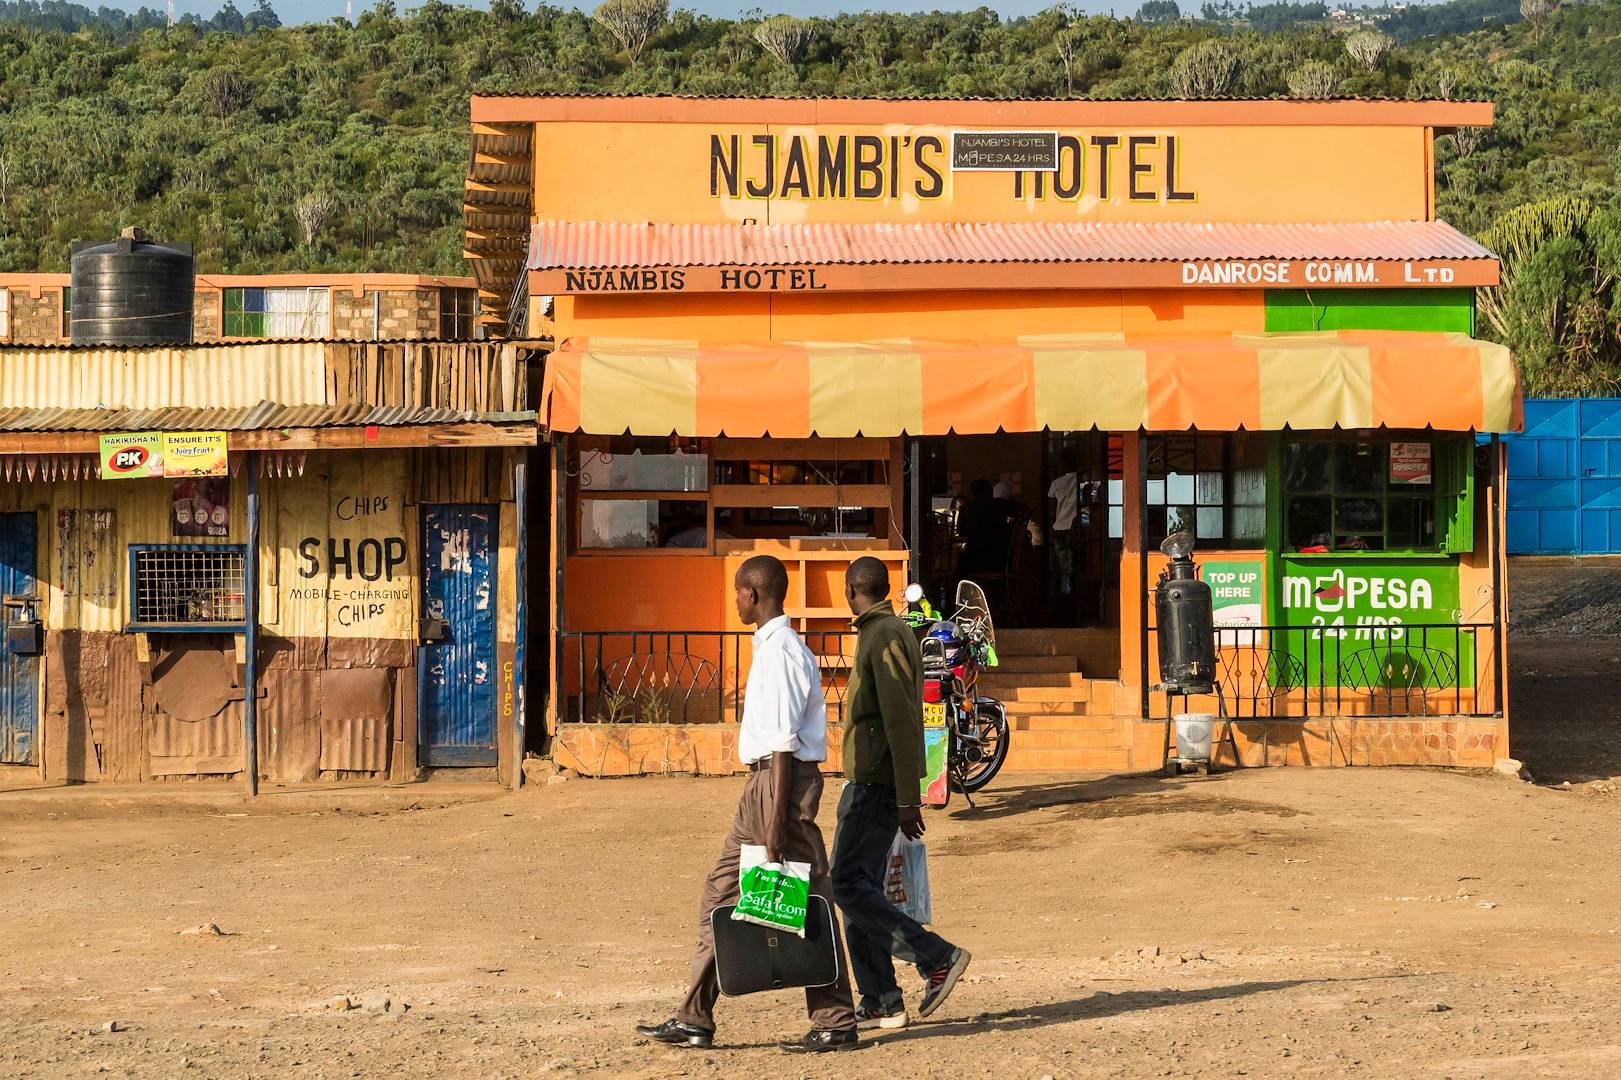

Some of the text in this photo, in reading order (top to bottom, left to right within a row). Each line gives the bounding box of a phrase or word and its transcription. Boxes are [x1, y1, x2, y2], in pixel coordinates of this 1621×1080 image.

[961, 138, 1047, 148] NJAMBI'S HOTEL
[710, 134, 946, 200] NJAMBI'S
[1013, 153, 1026, 163] 24
[1028, 153, 1050, 163] HRS
[565, 268, 827, 291] NJAMBIS HOTEL
[1182, 262, 1290, 284] DANROSE
[1305, 262, 1380, 284] COMM.
[104, 435, 159, 445] HAKIKISHA NI
[168, 435, 221, 444] ENSURE IT'S
[175, 447, 210, 456] Juicy Fruit
[337, 496, 389, 521] CHIPS
[298, 536, 407, 582] SHOP
[1208, 572, 1257, 584] TOP UP
[1215, 586, 1251, 598] HERE
[338, 603, 386, 627] CHIPS
[1311, 615, 1404, 641] 24 HRS
[503, 661, 513, 717] CHIPS
